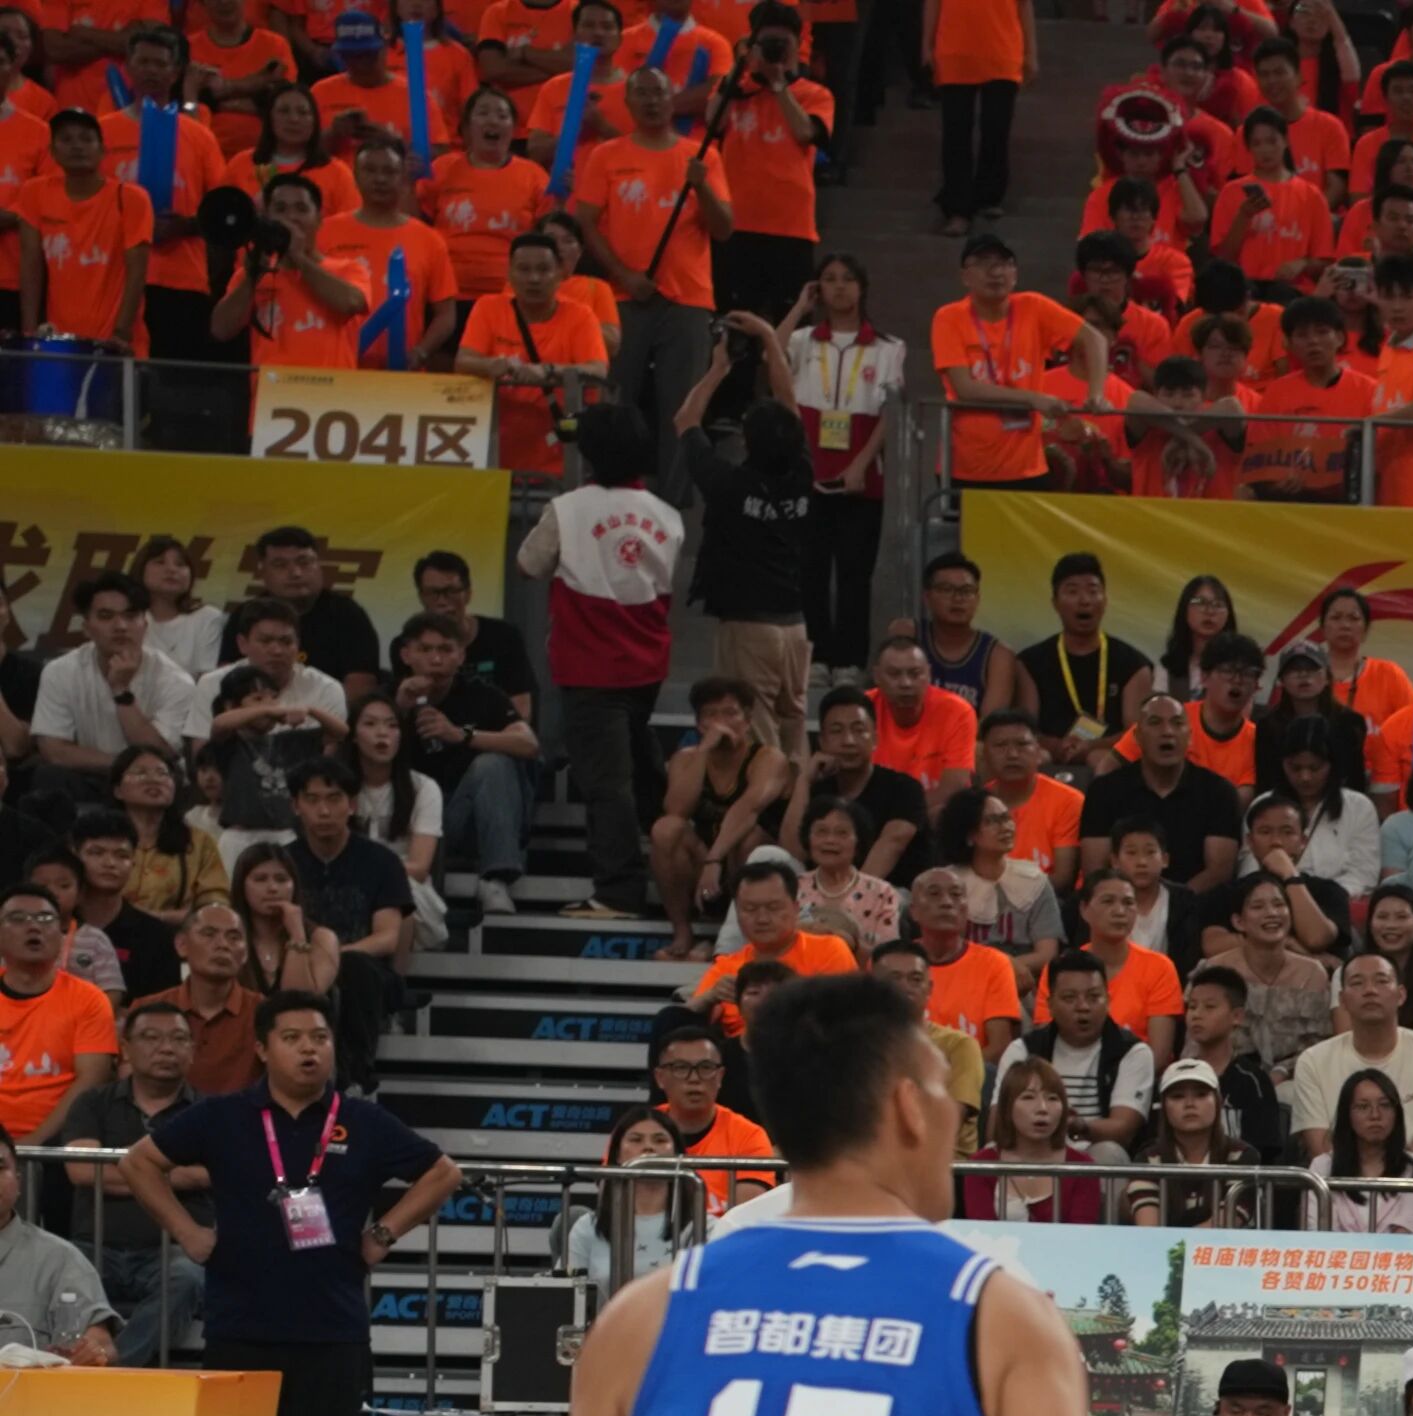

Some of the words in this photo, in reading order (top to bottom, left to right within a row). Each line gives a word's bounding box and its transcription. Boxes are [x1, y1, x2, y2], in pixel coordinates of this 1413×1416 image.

[265, 408, 477, 467] 204区
[580, 935, 645, 960] ACT
[532, 1015, 599, 1041] ACT
[481, 1103, 551, 1129] ACT
[704, 1309, 923, 1366] 智都集团
